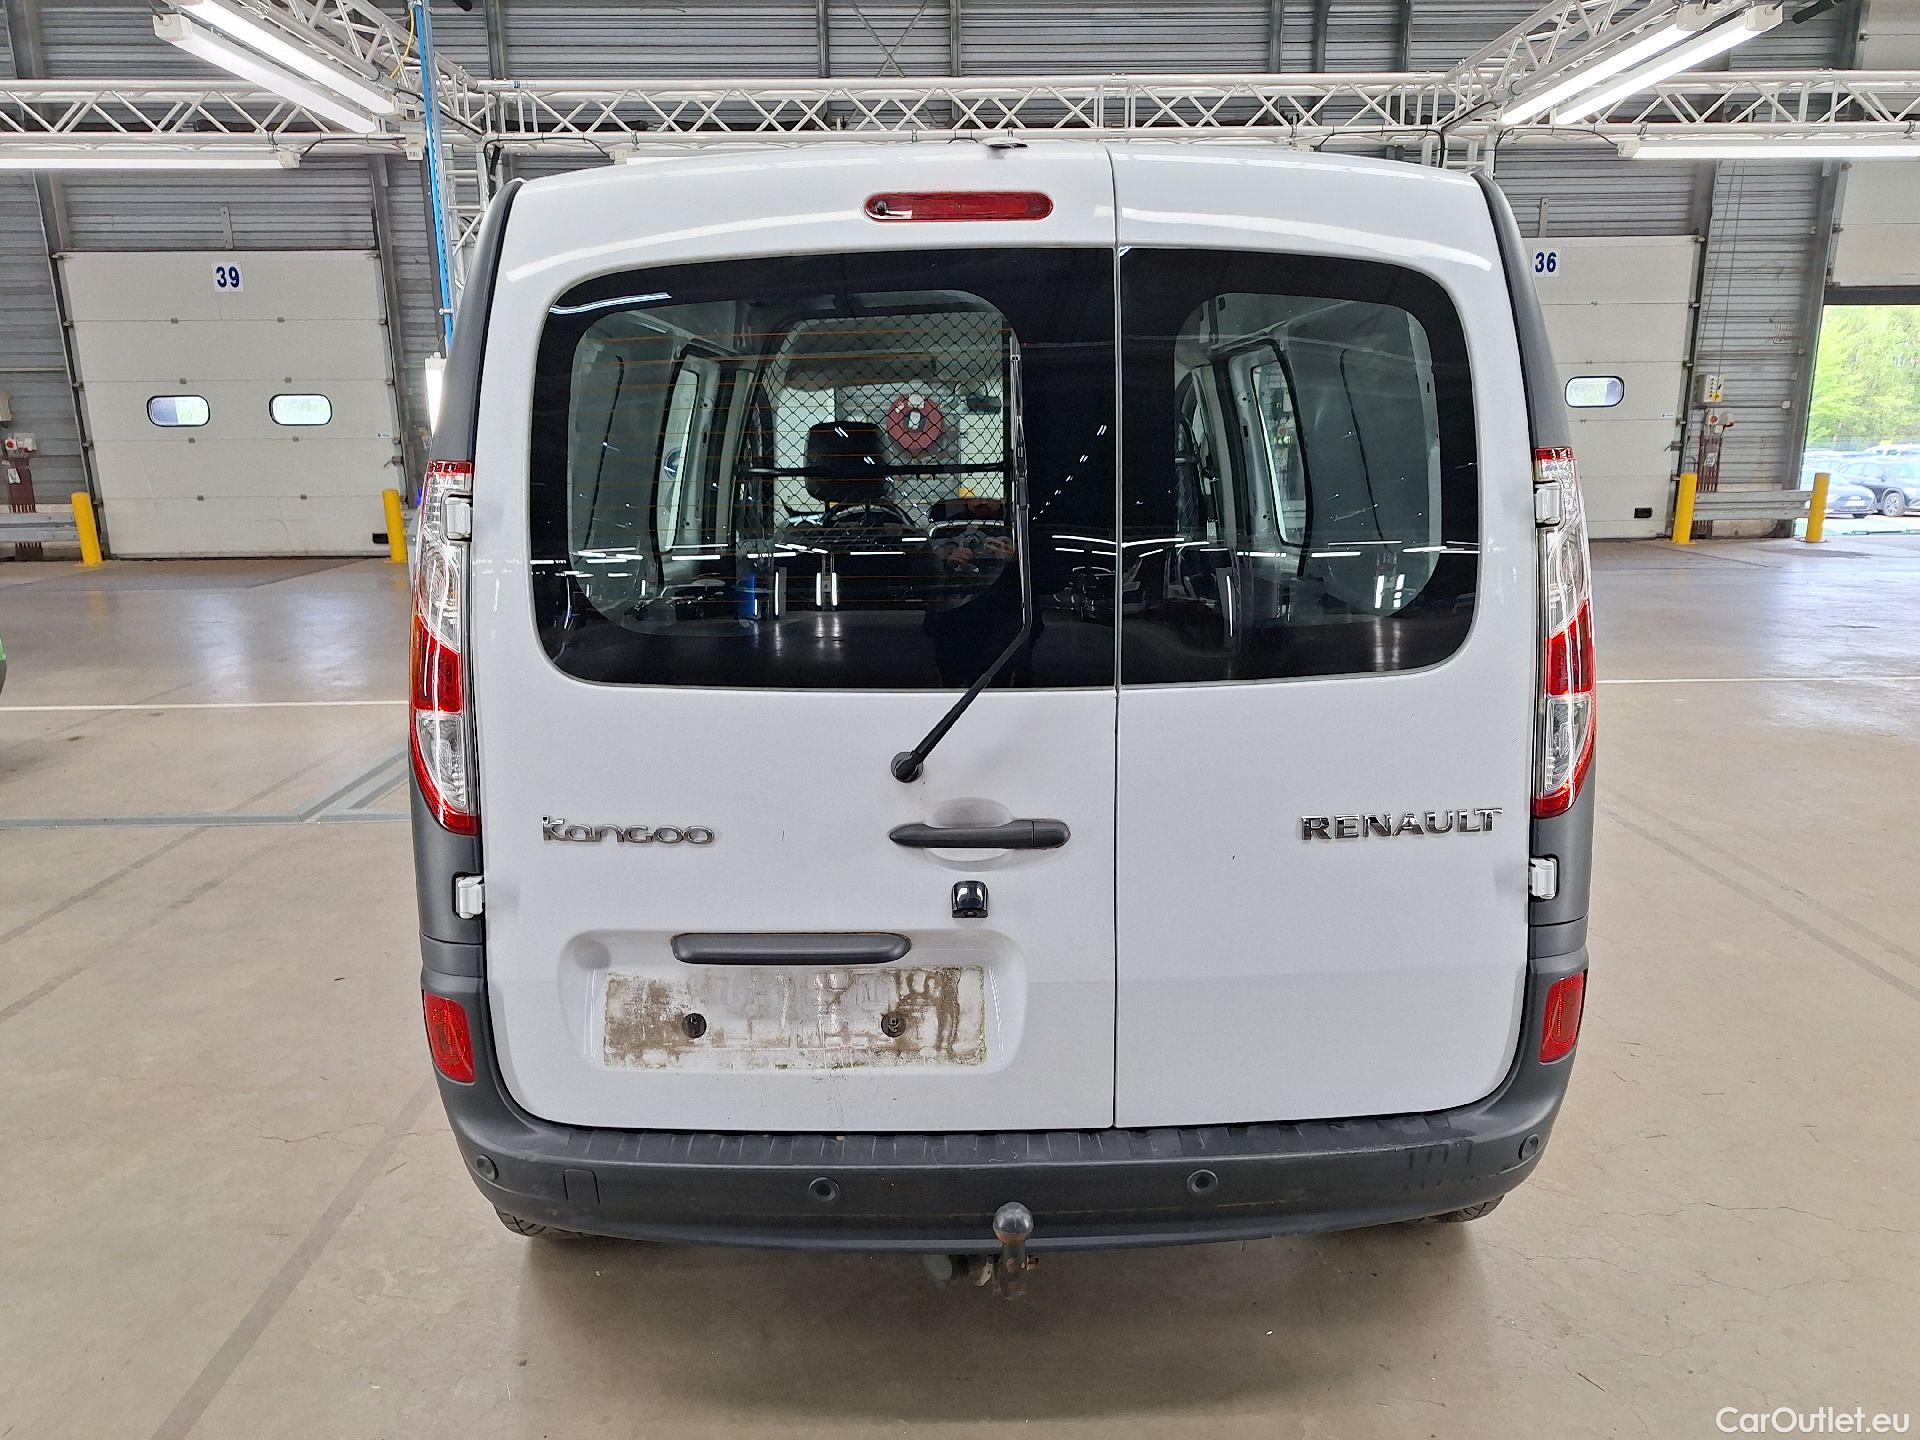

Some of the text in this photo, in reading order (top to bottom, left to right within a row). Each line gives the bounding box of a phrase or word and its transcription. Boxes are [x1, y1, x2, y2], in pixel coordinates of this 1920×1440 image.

[1535, 252, 1557, 273] 36
[216, 266, 240, 288] 39
[1300, 807, 1503, 841] RENAULT
